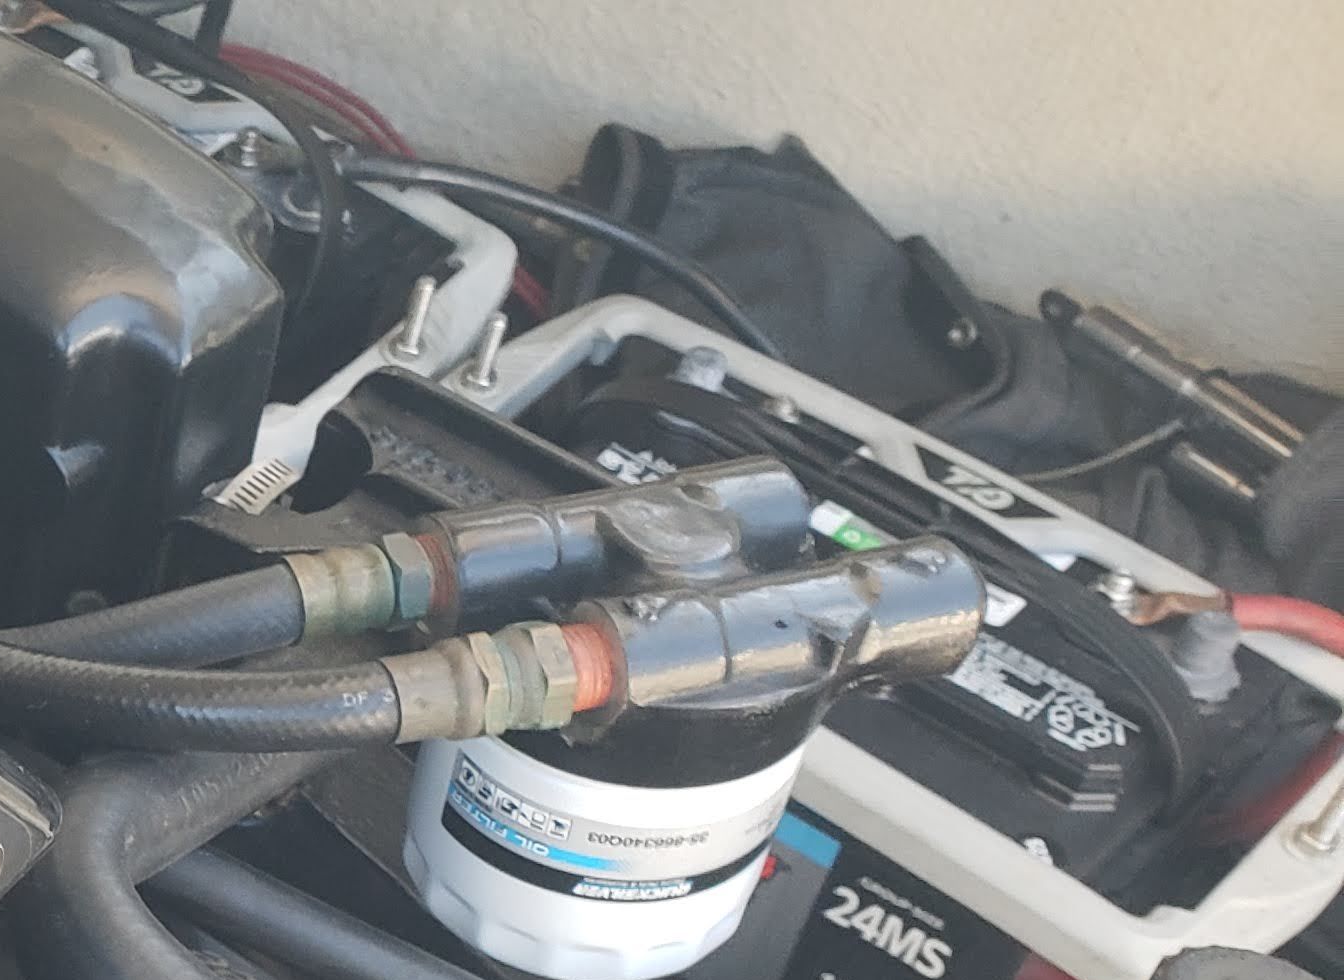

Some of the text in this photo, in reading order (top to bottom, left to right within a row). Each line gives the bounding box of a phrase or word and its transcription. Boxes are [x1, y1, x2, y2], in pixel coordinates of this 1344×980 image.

[451, 789, 551, 857] OIL FILTER
[824, 886, 953, 979] 24MS
